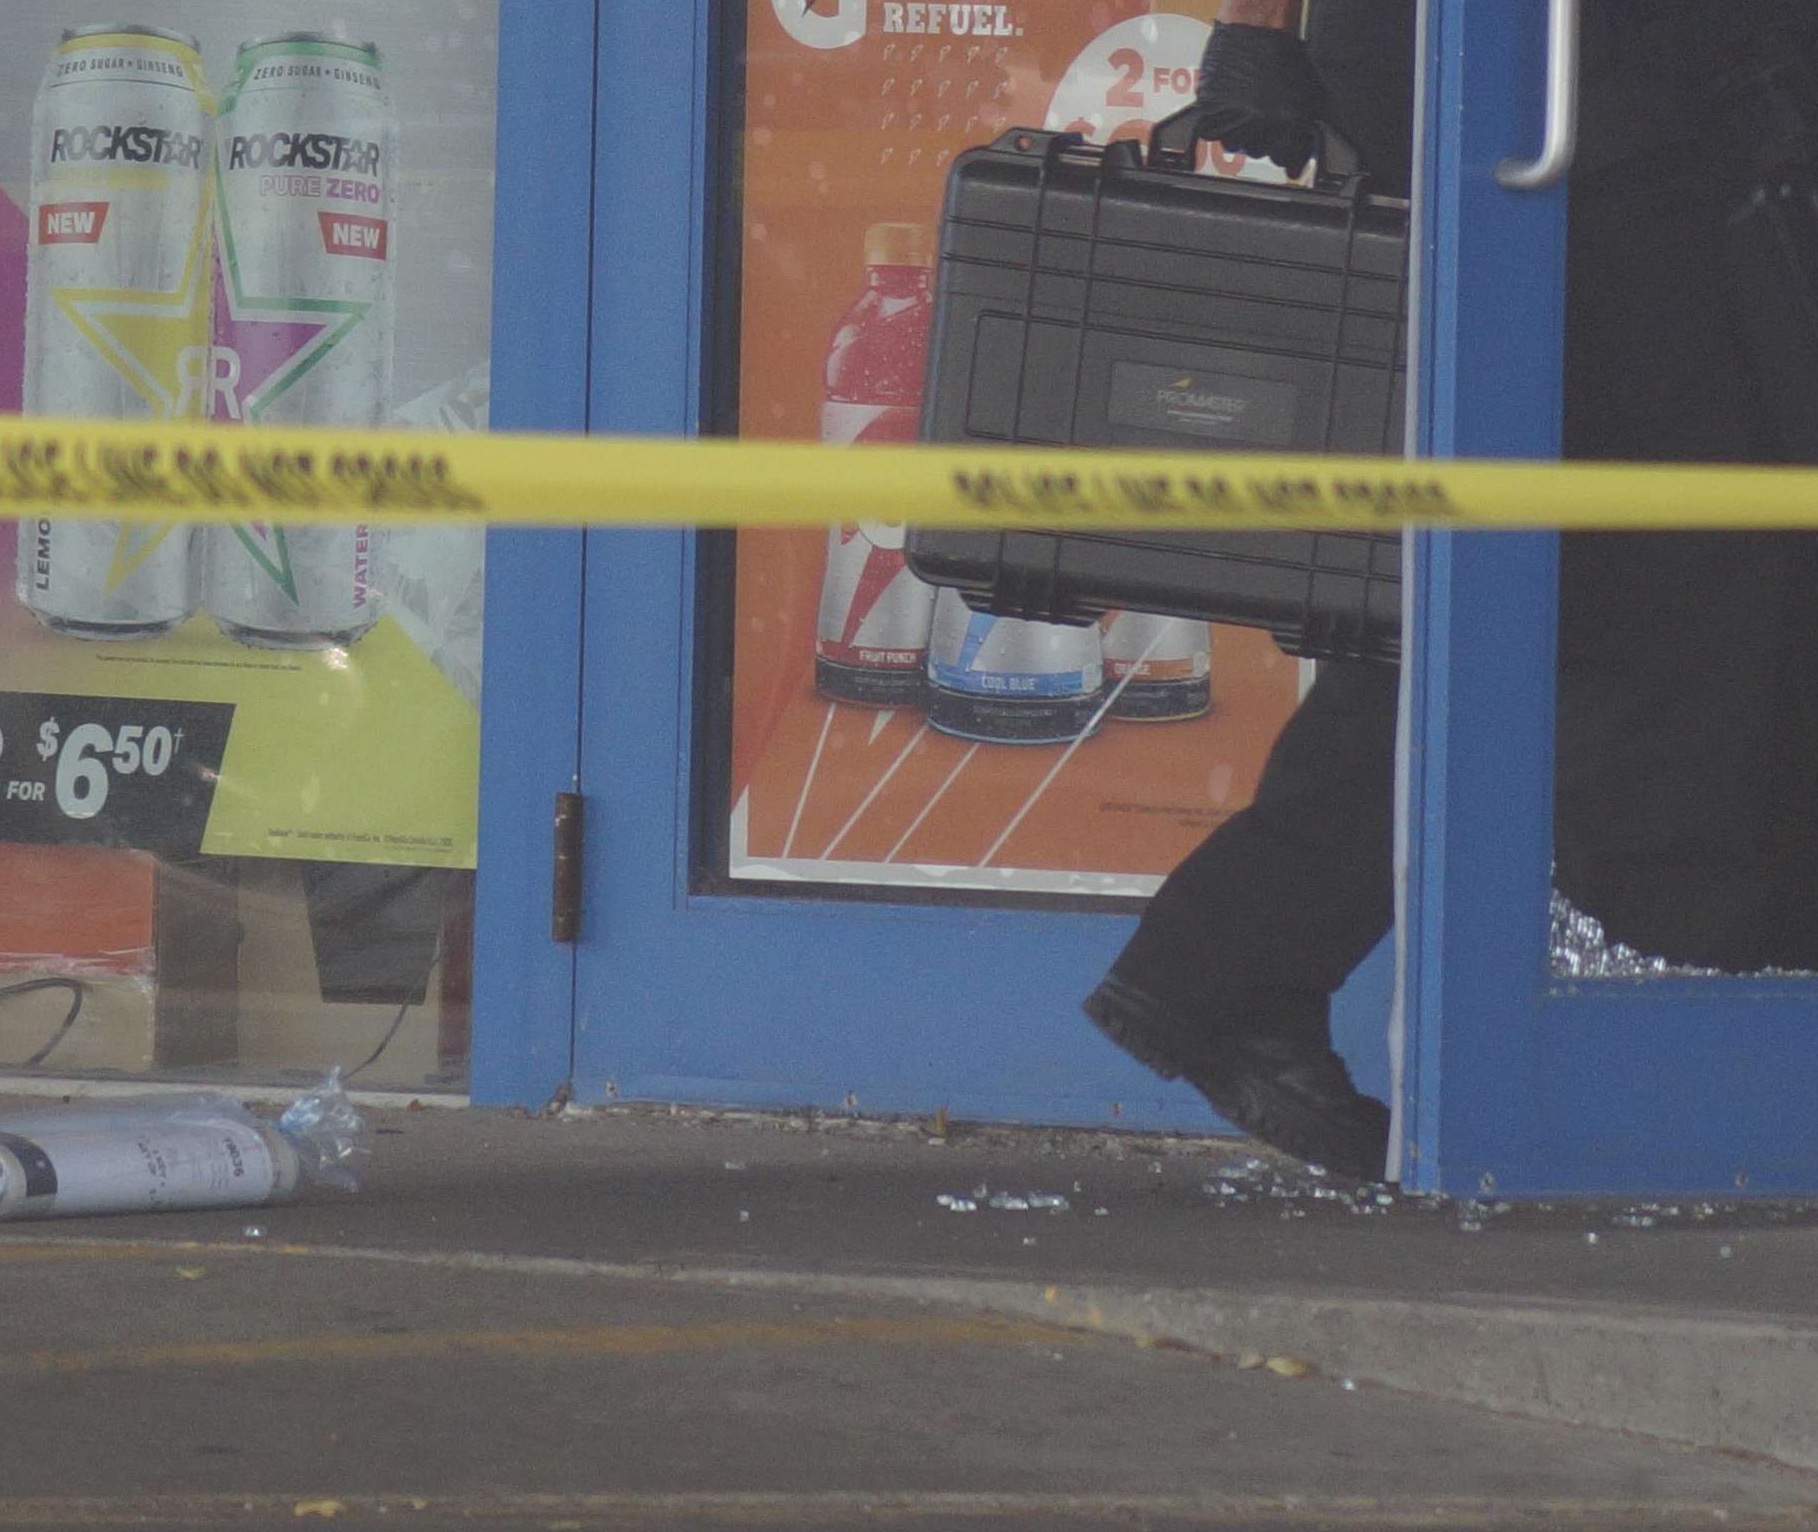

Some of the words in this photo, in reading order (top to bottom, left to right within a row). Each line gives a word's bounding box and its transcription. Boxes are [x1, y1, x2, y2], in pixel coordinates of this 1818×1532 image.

[883, 0, 1025, 37] REFUEL.
[56, 59, 87, 78] ZERO
[90, 56, 125, 71] SUGAR
[135, 58, 184, 78] GINSENG
[253, 66, 284, 81] ZERO
[287, 65, 322, 79] SUGAR
[1105, 48, 1145, 108] 2
[51, 125, 200, 169] ROCKSTAR
[229, 131, 380, 177] ROCKSTAR
[260, 174, 320, 198] PURE
[326, 176, 380, 204] ZERO
[47, 211, 94, 235] NEW
[332, 221, 380, 250] NEW
[859, 648, 887, 663] FRUIT
[888, 649, 918, 664] PUNCH
[980, 675, 1007, 692] COOL
[1009, 676, 1037, 693] BLUE
[6, 780, 46, 801] FOR
